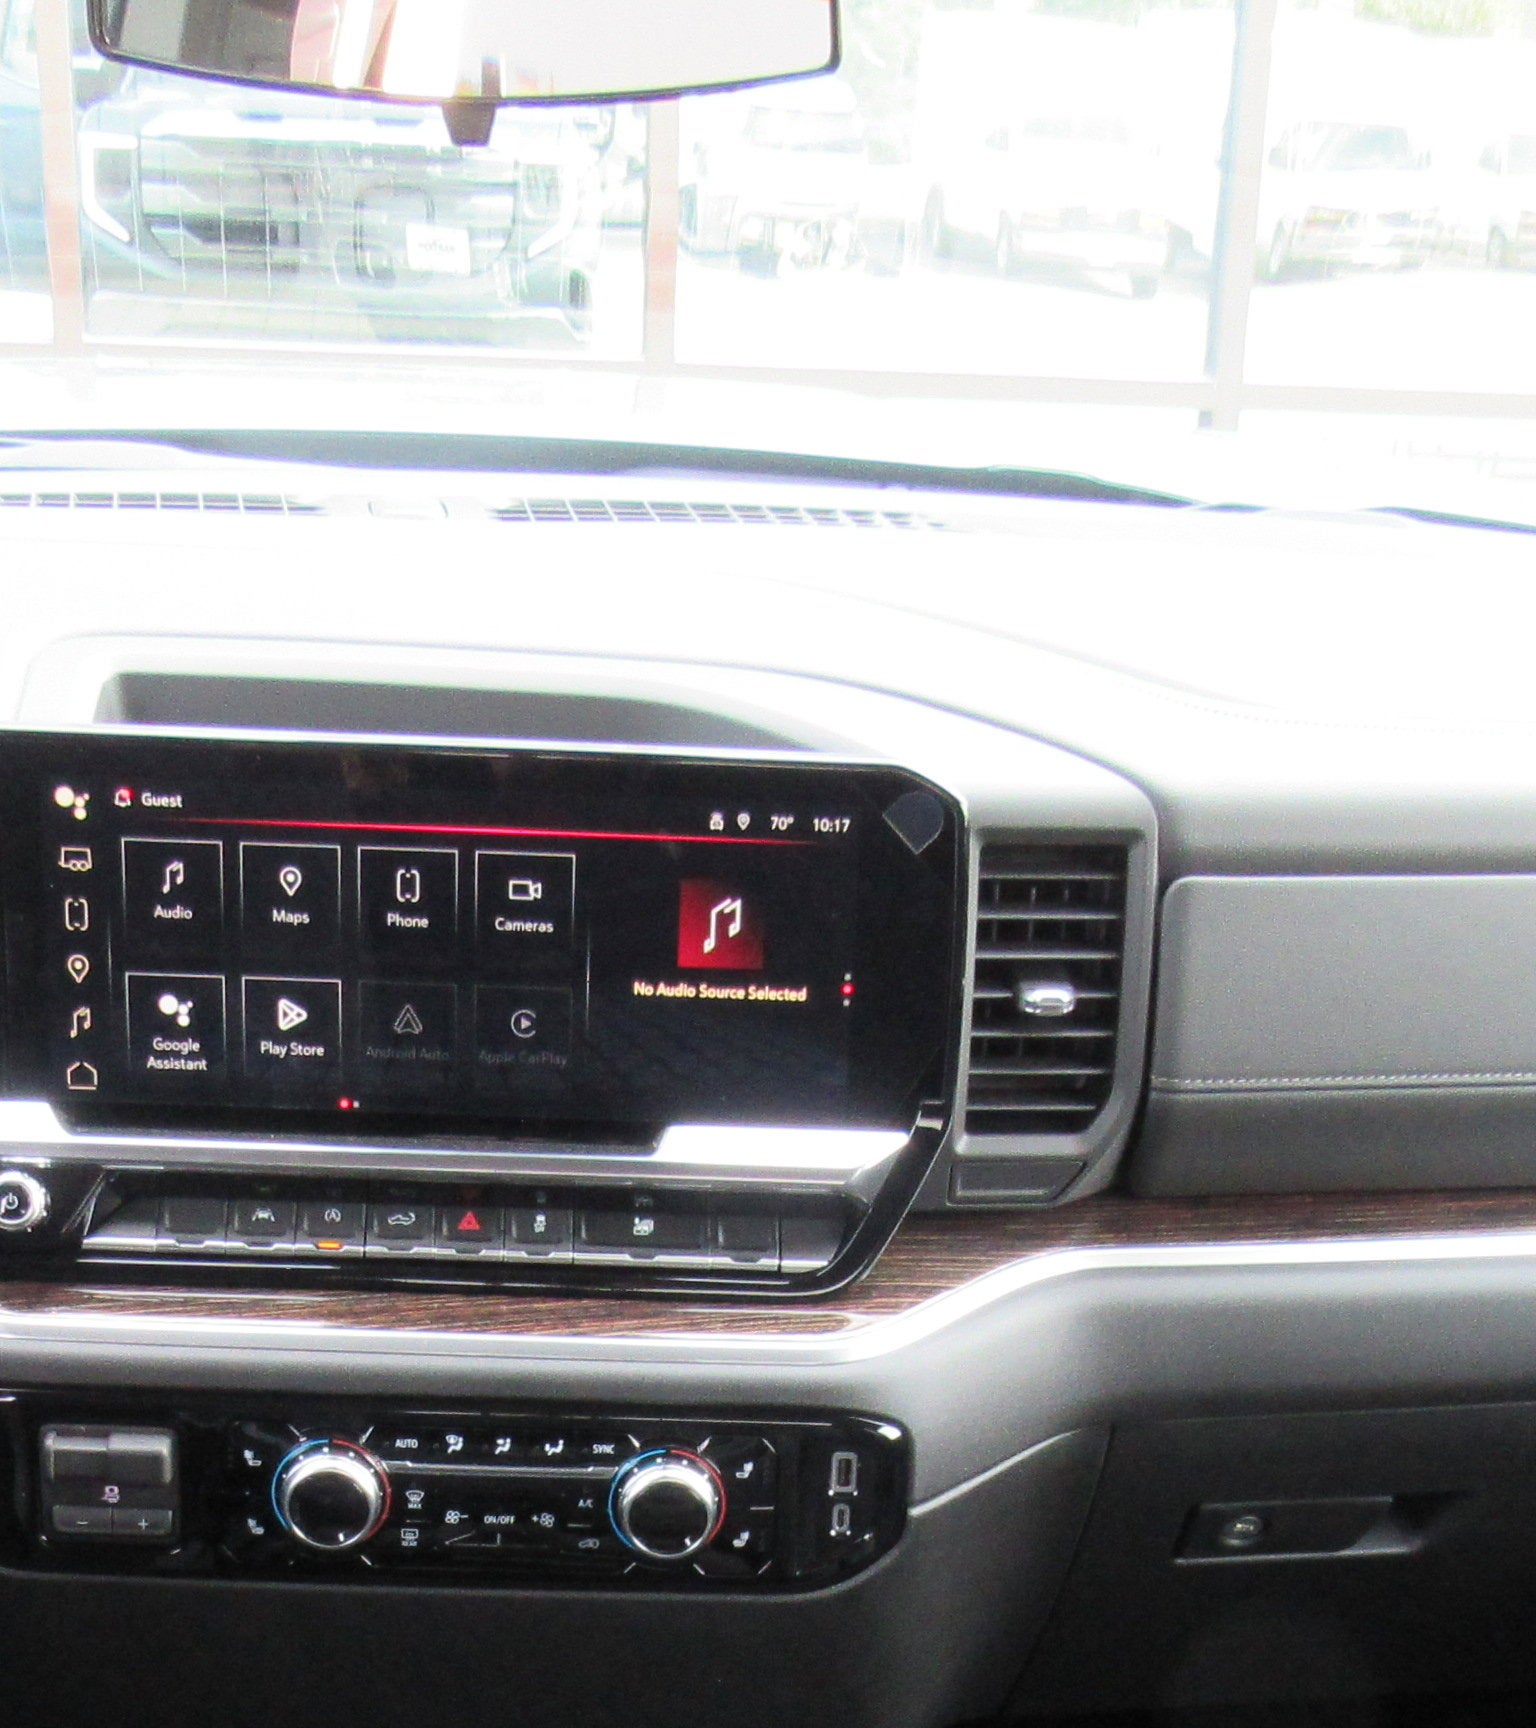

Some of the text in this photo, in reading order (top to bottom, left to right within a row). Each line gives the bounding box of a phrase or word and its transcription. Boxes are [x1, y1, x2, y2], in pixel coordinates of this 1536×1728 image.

[141, 792, 183, 808] Guest
[770, 815, 851, 832] 70° 10:17
[154, 905, 193, 920] Audio
[272, 907, 311, 926] Maps
[386, 911, 430, 929] Phone
[494, 917, 554, 933] Cameras
[634, 981, 808, 1002] No Audio Source Selected
[152, 1037, 200, 1055] Google
[260, 1040, 325, 1059] Play Store
[366, 1046, 450, 1060] Android Auto
[146, 1056, 208, 1071] Assistant
[479, 1050, 567, 1066] Apple CarPlay
[395, 1438, 418, 1449] AUTO
[592, 1444, 615, 1454] SYNC
[578, 1499, 594, 1509] A/C
[484, 1515, 515, 1525] ON/OFF
